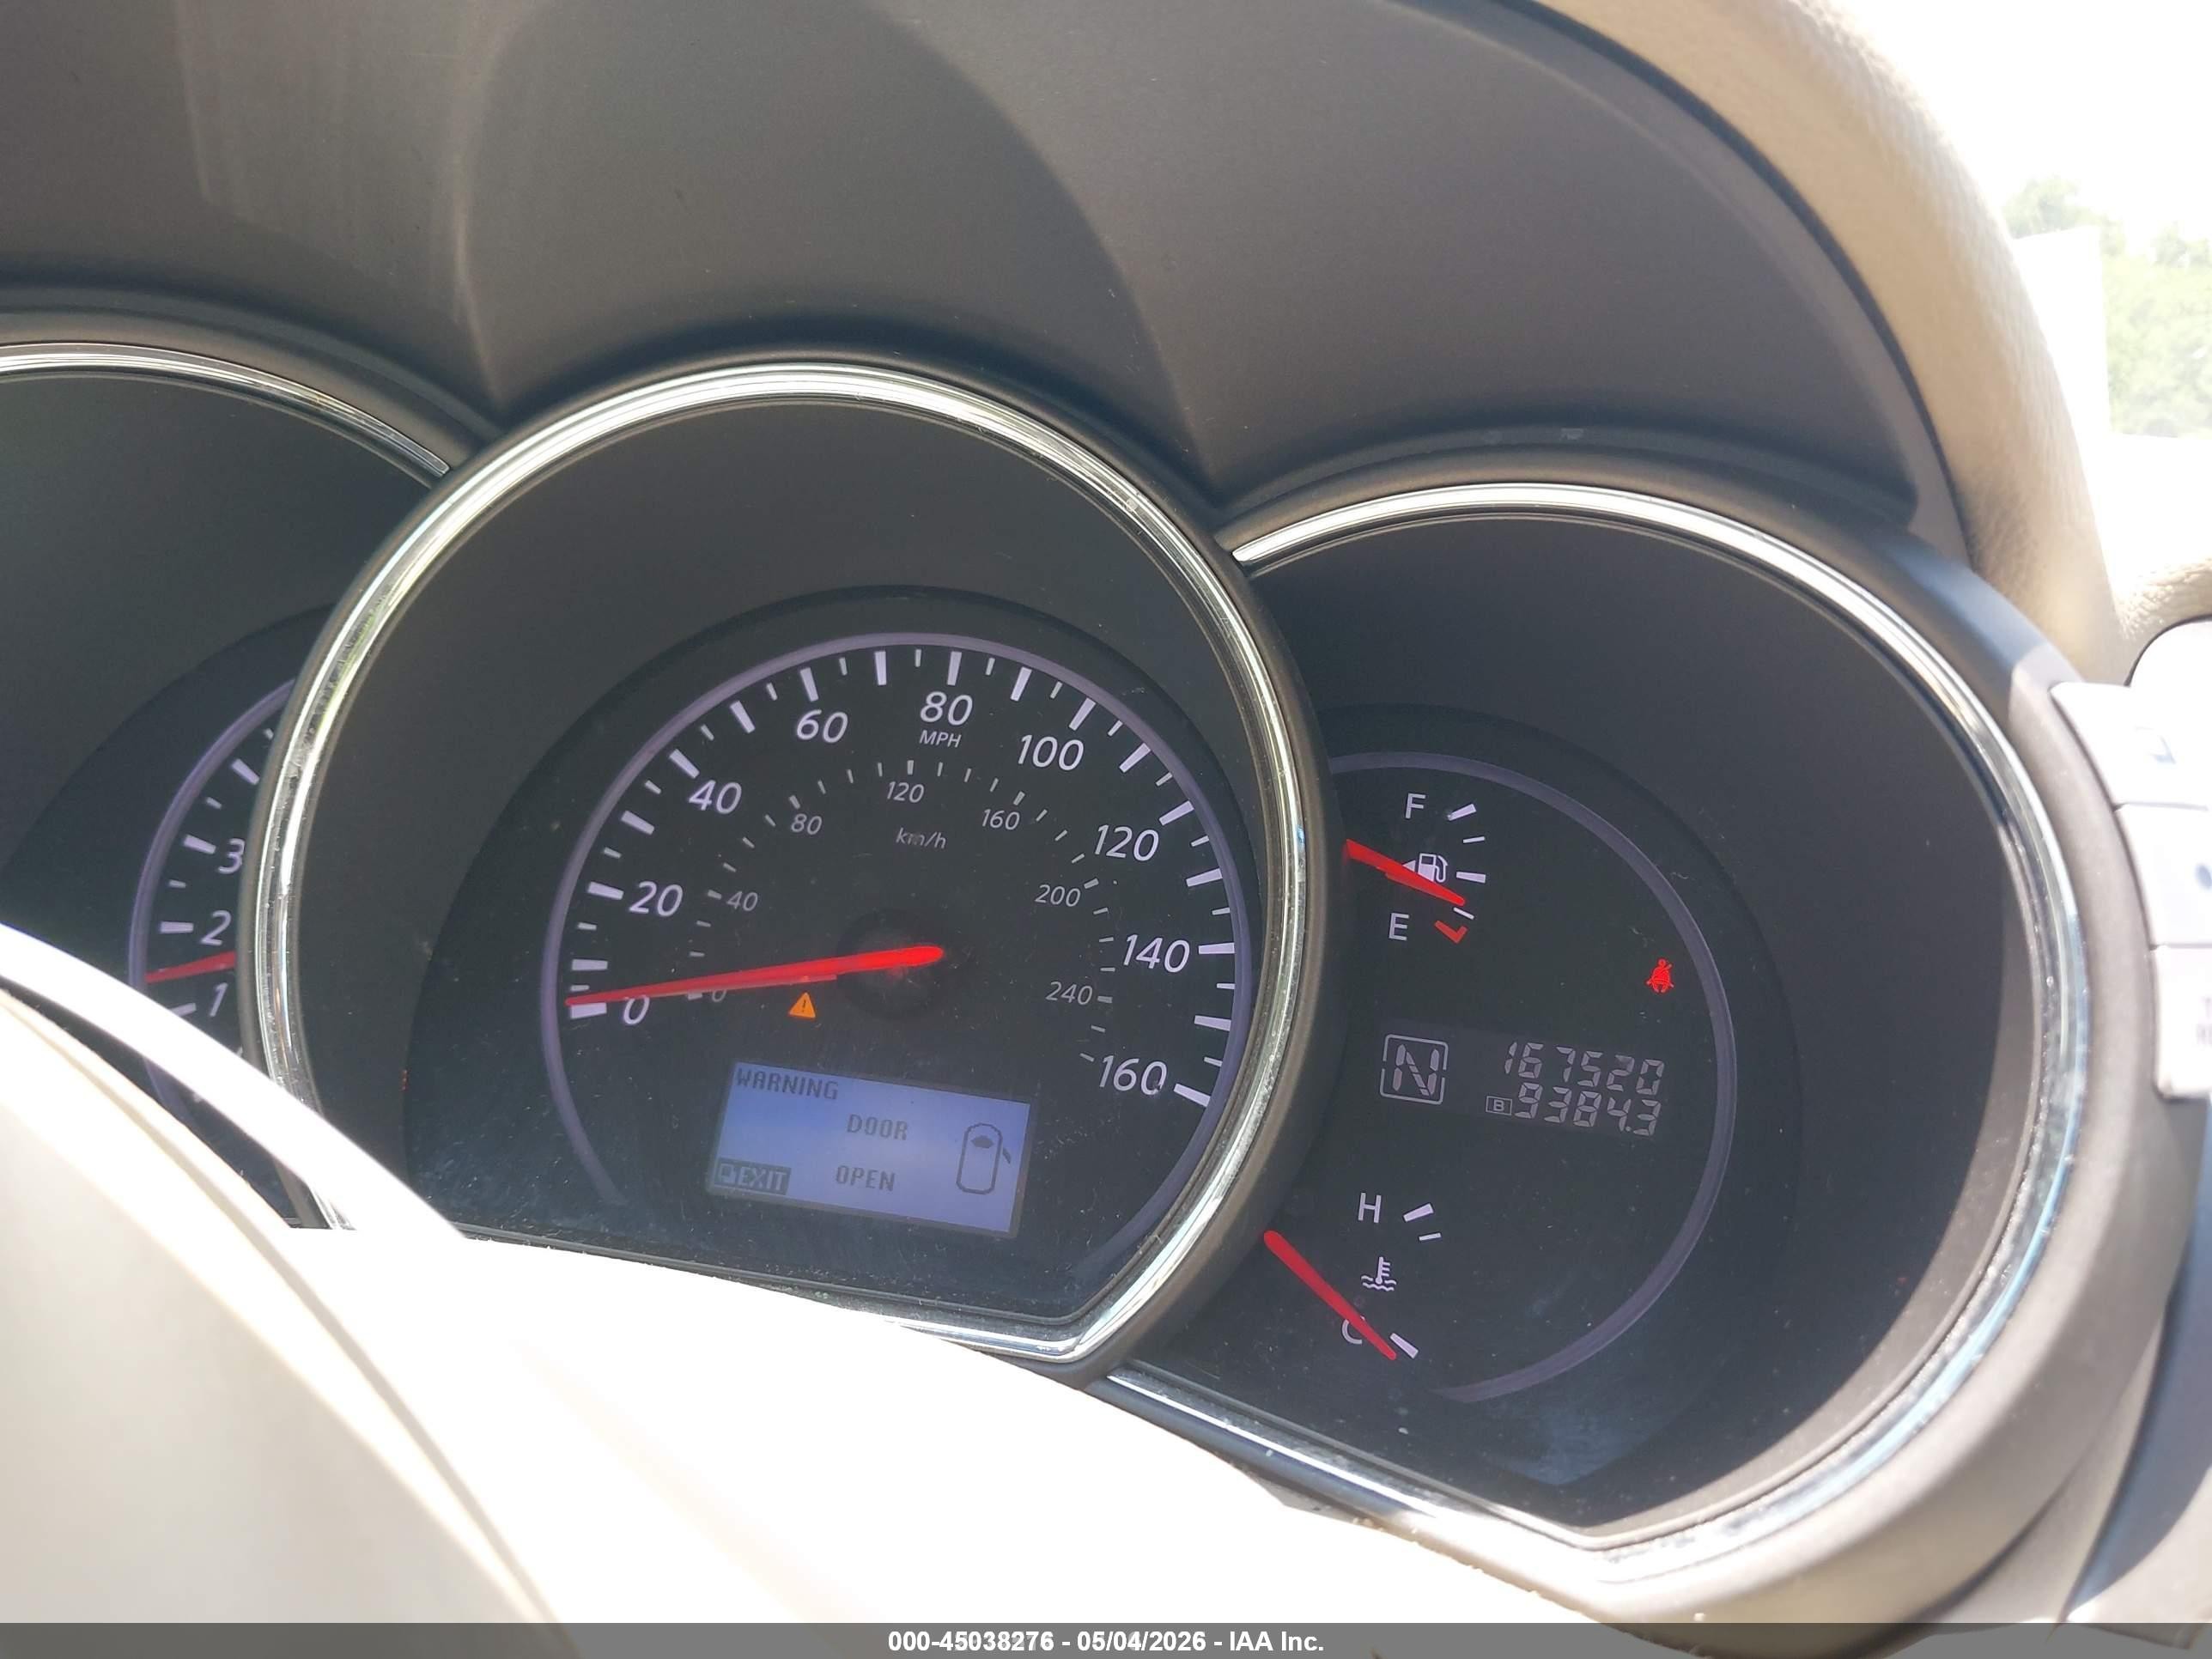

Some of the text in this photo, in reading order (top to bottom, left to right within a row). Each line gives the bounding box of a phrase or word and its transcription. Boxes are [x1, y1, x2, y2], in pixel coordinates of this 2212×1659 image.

[920, 691, 973, 726] 80
[795, 709, 848, 743] 60
[919, 730, 962, 748] MPH
[1018, 734, 1085, 771] 100
[689, 780, 742, 814] 40
[887, 781, 925, 803] 120
[1405, 793, 1425, 819] F
[790, 813, 823, 835] 80
[982, 809, 1020, 830] 160
[896, 827, 946, 849] km/h
[1095, 824, 1159, 861] 120
[217, 838, 246, 873] 3
[629, 880, 684, 917] 20
[726, 890, 758, 912] 40
[1035, 884, 1081, 907] 200
[200, 910, 232, 945] 2
[1389, 913, 1409, 941] E
[1123, 934, 1190, 973] 140
[210, 982, 228, 1017] 1
[623, 994, 650, 1024] 0
[1046, 981, 1092, 1005] 240
[736, 1067, 839, 1100] WARNING
[1099, 1055, 1167, 1096] 160
[1393, 1044, 1440, 1096] N
[1504, 1042, 1664, 1096] 167520
[1515, 1082, 1662, 1136] 9384.3
[847, 1114, 908, 1141] DOOR
[738, 1166, 786, 1192] EXIT
[836, 1164, 896, 1192] OPEN
[1358, 1192, 1382, 1224] H
